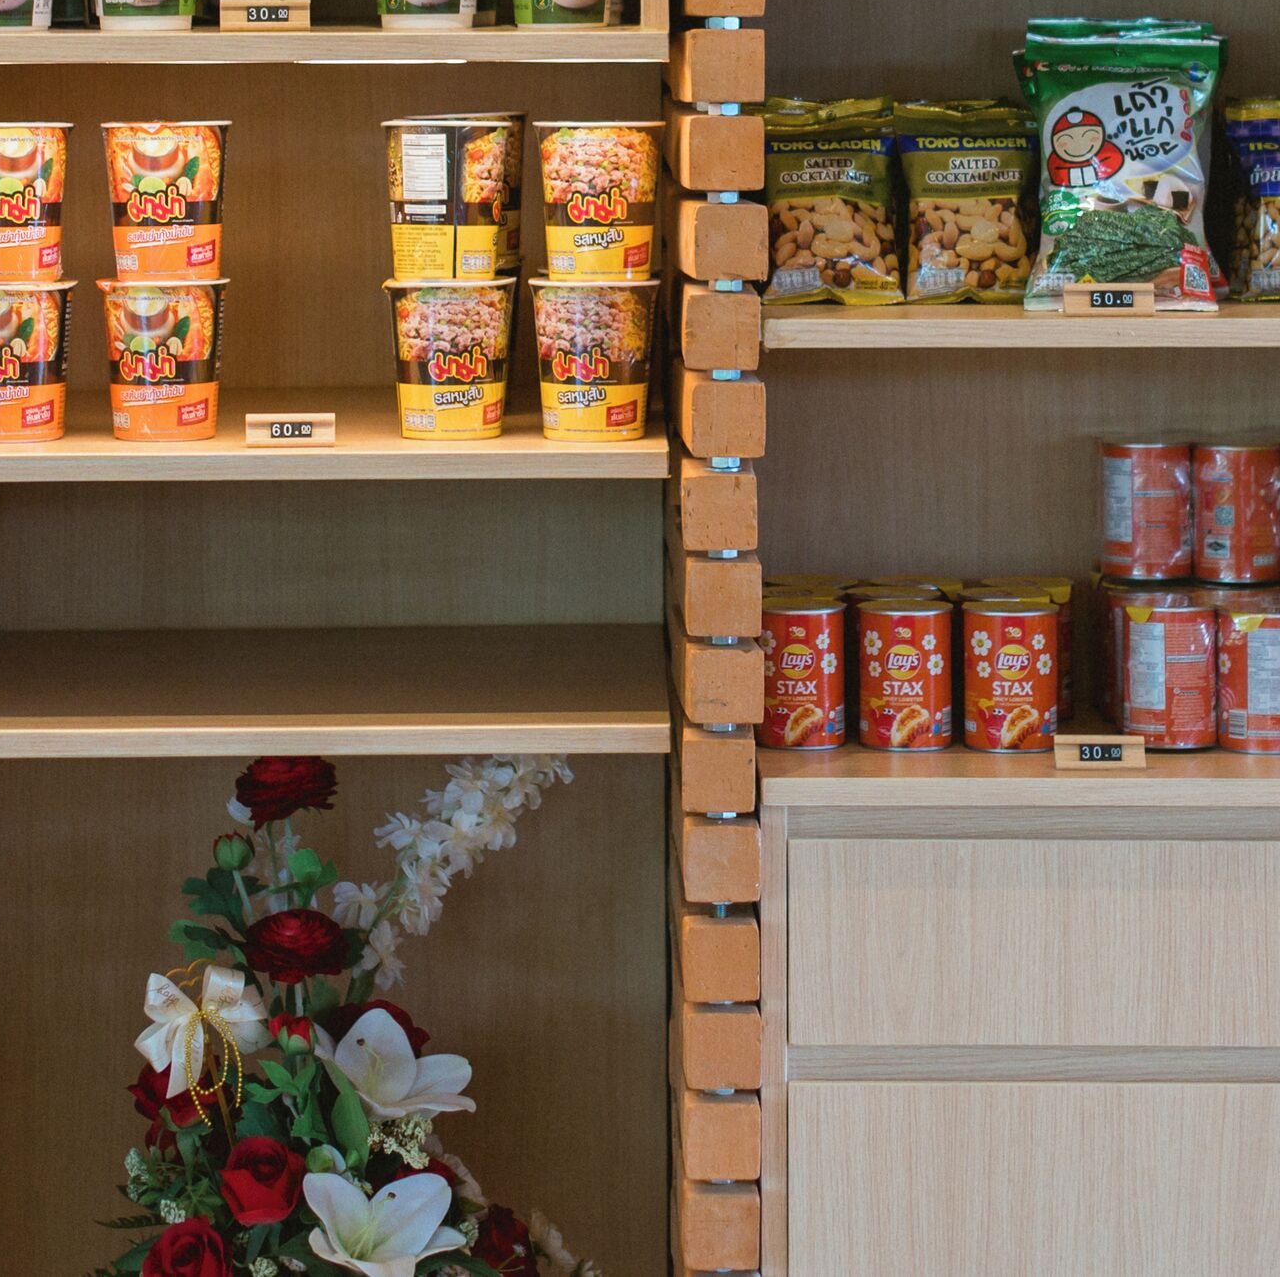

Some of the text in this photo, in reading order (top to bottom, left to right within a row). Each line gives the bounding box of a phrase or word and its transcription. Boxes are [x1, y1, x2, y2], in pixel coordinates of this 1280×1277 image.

[248, 8, 288, 20] 30.00
[771, 140, 881, 151] TONG GARDEN
[916, 138, 1026, 148] TONG GARDEN
[805, 158, 853, 168] SALTED
[951, 159, 998, 169] SALTED
[782, 171, 843, 183] COCKTAIL
[927, 171, 1024, 182] COCKTAIL NUTS
[127, 185, 185, 222] มาม่า
[567, 188, 627, 224] มาม่า
[574, 229, 624, 248] รสหมูสับ
[1093, 293, 1133, 305] 50.00
[120, 346, 176, 382] มาม่า
[428, 346, 487, 383] มาม่า
[552, 346, 609, 382] มาม่า
[433, 386, 484, 405] รสหมูสับ
[557, 387, 606, 406] รสหมูสับ
[272, 423, 311, 436] 60.00
[782, 653, 813, 671] Lay's
[888, 653, 919, 671] Lay's
[997, 653, 1029, 671] Lay's
[776, 681, 817, 694] STAX
[883, 682, 923, 695] STAX
[992, 682, 1033, 695] STAX
[1082, 746, 1121, 759] 30.00
